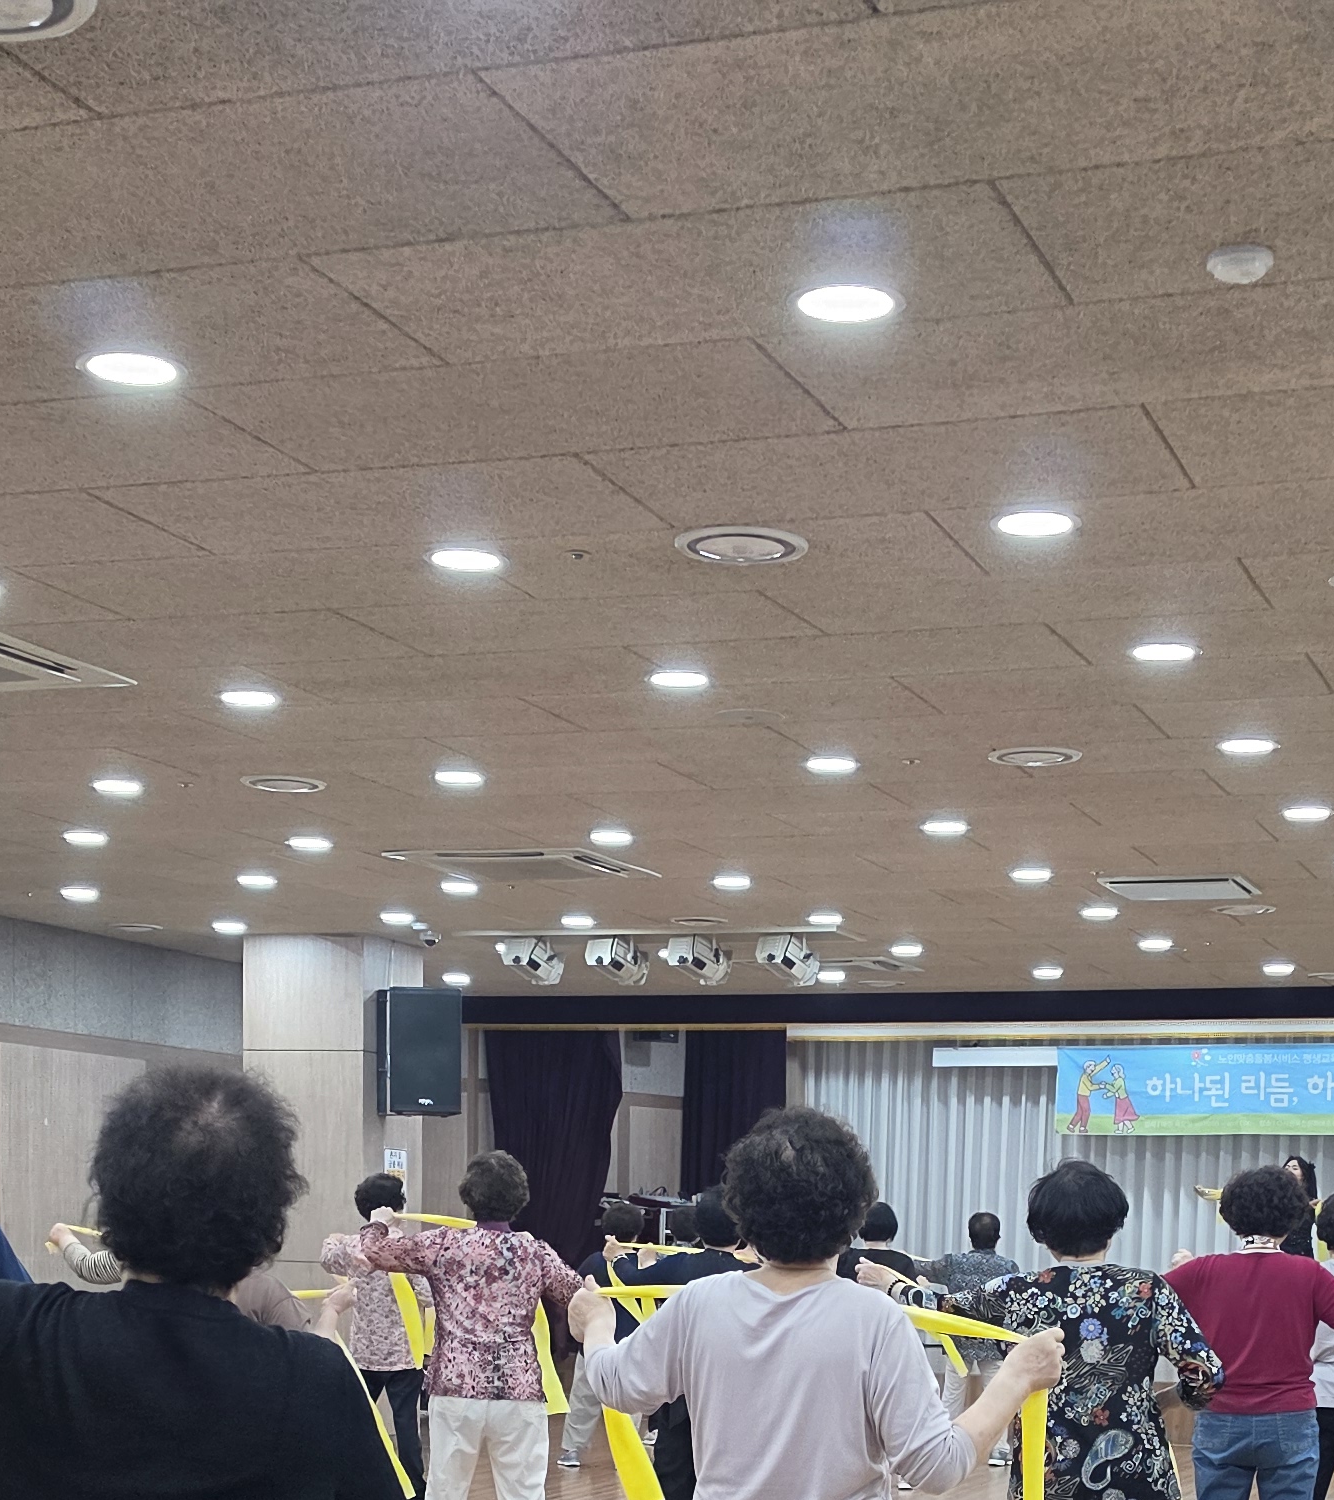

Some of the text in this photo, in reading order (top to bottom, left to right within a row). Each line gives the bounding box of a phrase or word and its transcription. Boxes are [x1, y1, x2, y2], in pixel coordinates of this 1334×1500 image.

[1217, 1053, 1301, 1065] 노인맞춤돌봄서비스
[1146, 1071, 1231, 1108] 하나된
[1240, 1071, 1300, 1108] 리듬,
